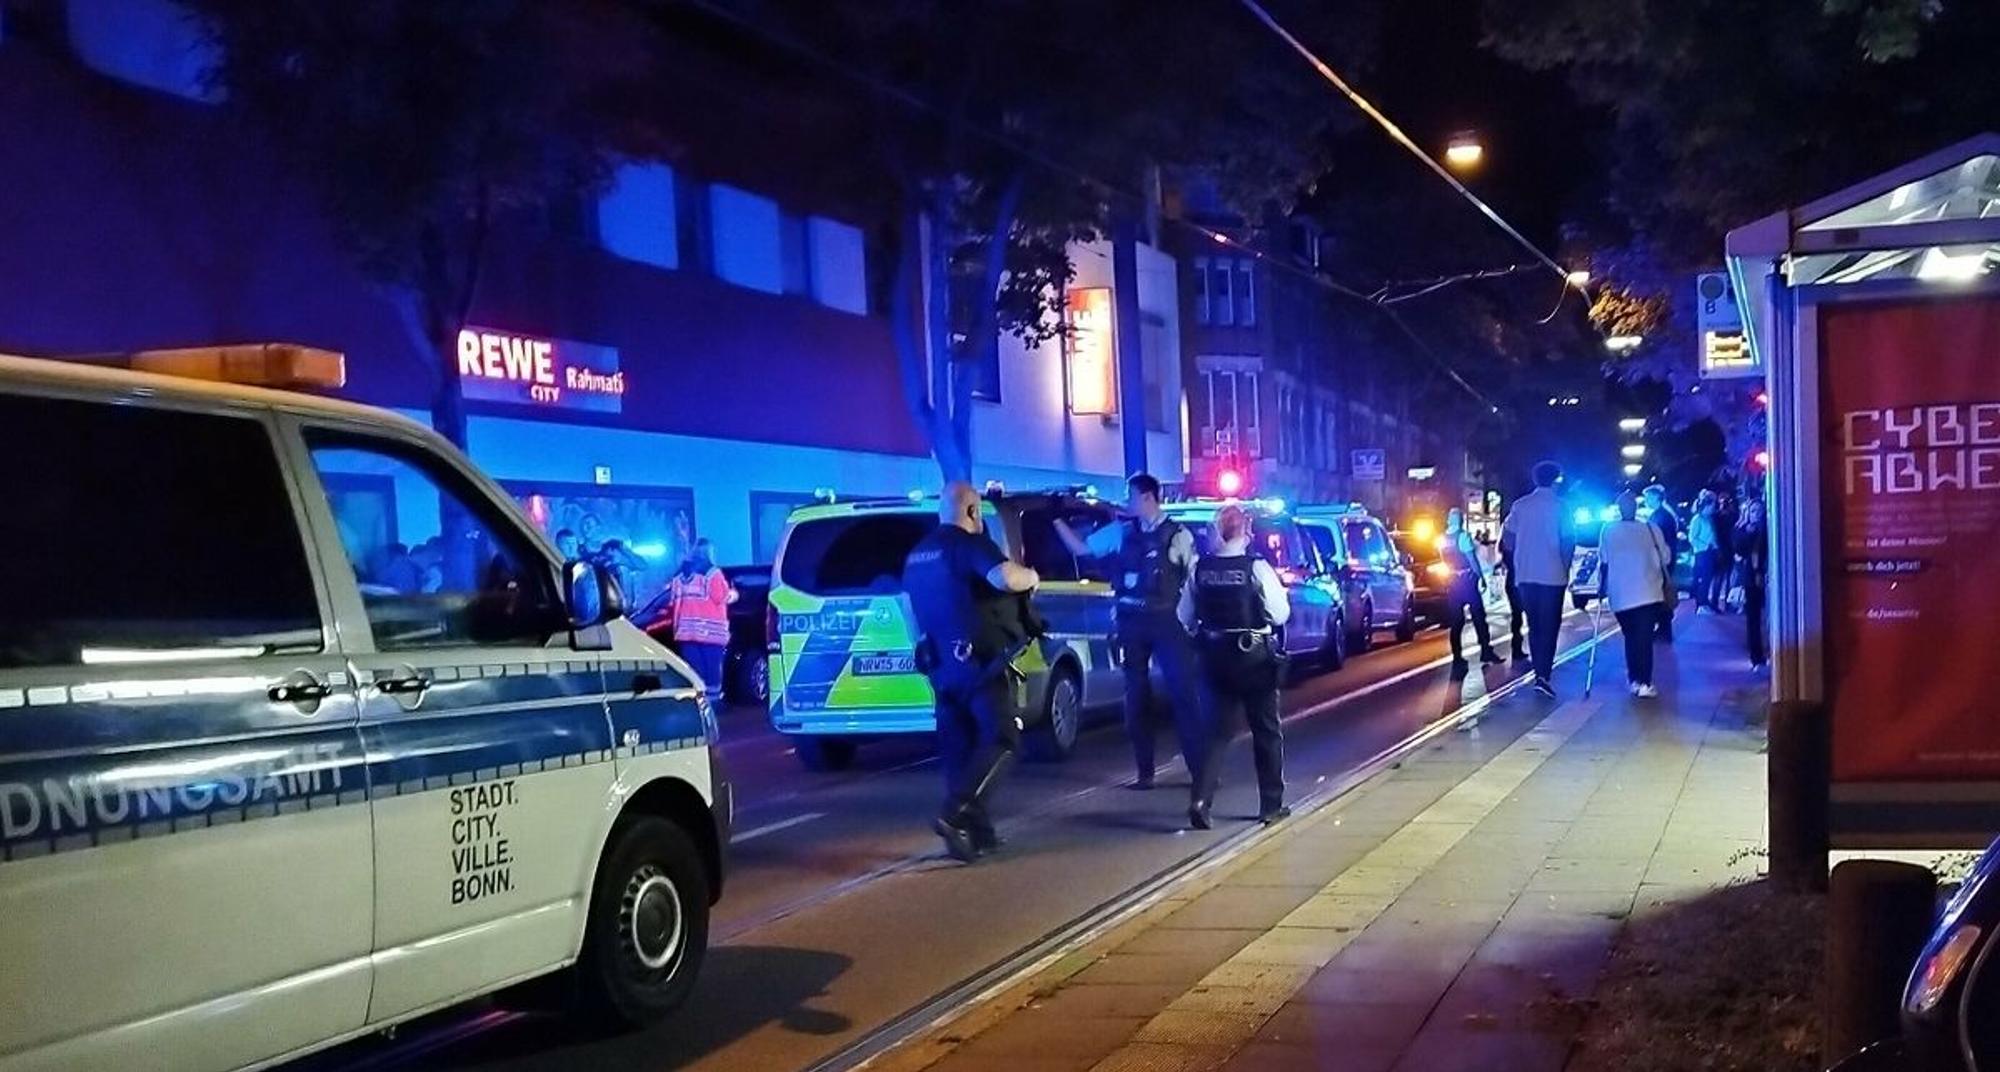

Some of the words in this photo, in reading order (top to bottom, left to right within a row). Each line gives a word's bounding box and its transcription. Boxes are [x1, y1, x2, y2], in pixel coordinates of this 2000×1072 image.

[458, 330, 554, 384] REWE
[531, 385, 560, 402] CITY
[566, 366, 624, 393] Rahmati
[1844, 403, 2000, 450] CYBE
[1845, 448, 2000, 494] ABWE
[783, 615, 857, 631] POLIZEI
[450, 781, 519, 815] STADT.
[452, 813, 501, 844] CITY.
[452, 840, 514, 874] VILLE.
[452, 868, 515, 904] BONN.
